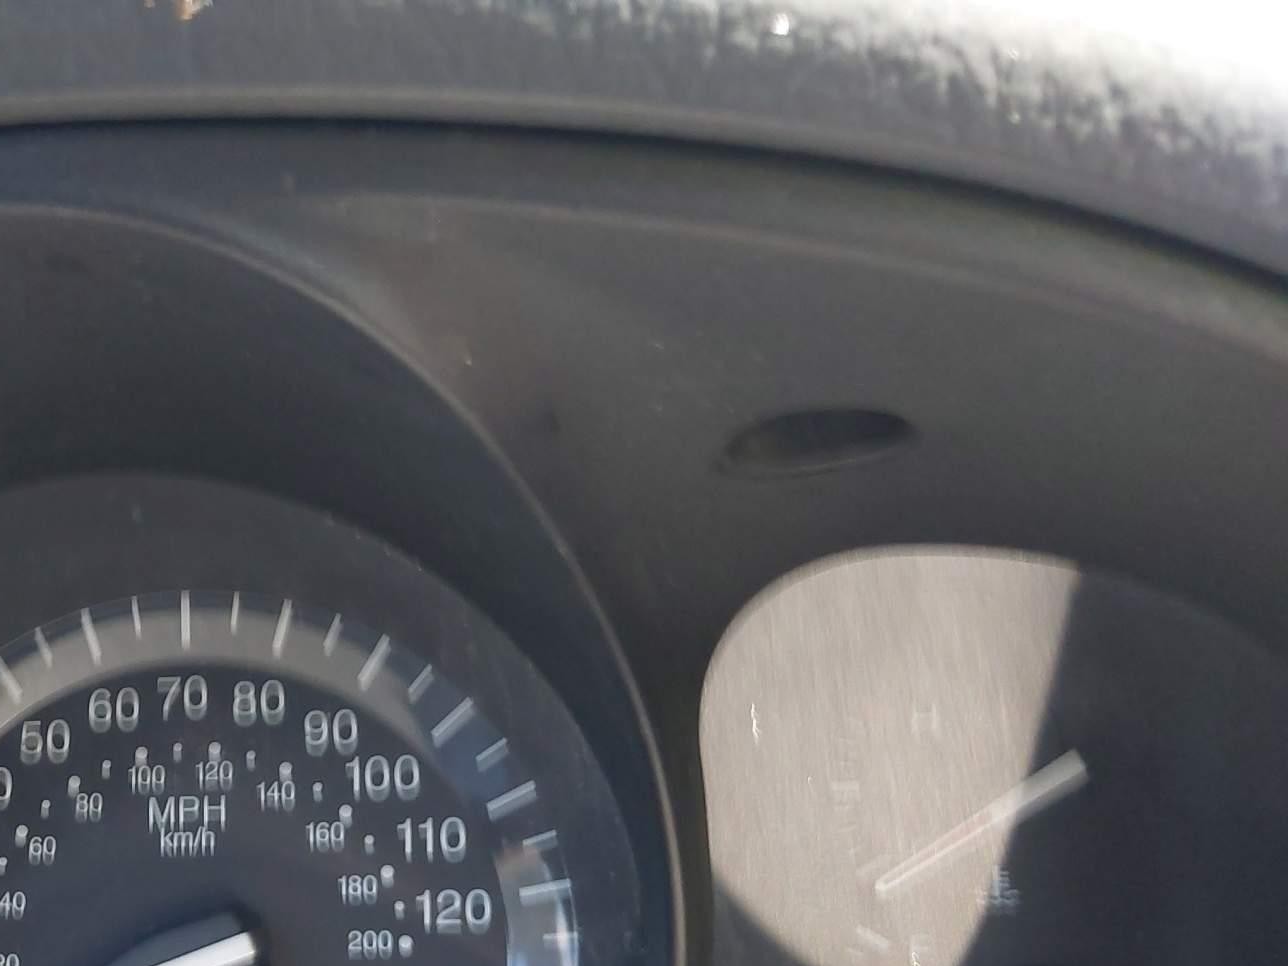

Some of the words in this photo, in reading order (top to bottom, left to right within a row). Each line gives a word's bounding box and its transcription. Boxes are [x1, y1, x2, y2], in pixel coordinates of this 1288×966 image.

[89, 687, 140, 730] 60
[157, 675, 208, 719] 70
[233, 680, 285, 725] 80
[20, 719, 70, 761] 50
[304, 709, 358, 755] 90
[128, 765, 166, 794] 100
[196, 761, 233, 789] 120
[345, 755, 420, 800] 100
[75, 793, 103, 821] 80
[257, 780, 296, 811] 140
[148, 795, 226, 832] MPH
[29, 836, 56, 865] 60
[160, 826, 216, 857] km/h
[306, 821, 344, 850] 160
[397, 816, 466, 861] 110
[338, 875, 378, 903] 180
[416, 889, 492, 933] 120
[348, 930, 394, 959] 200
